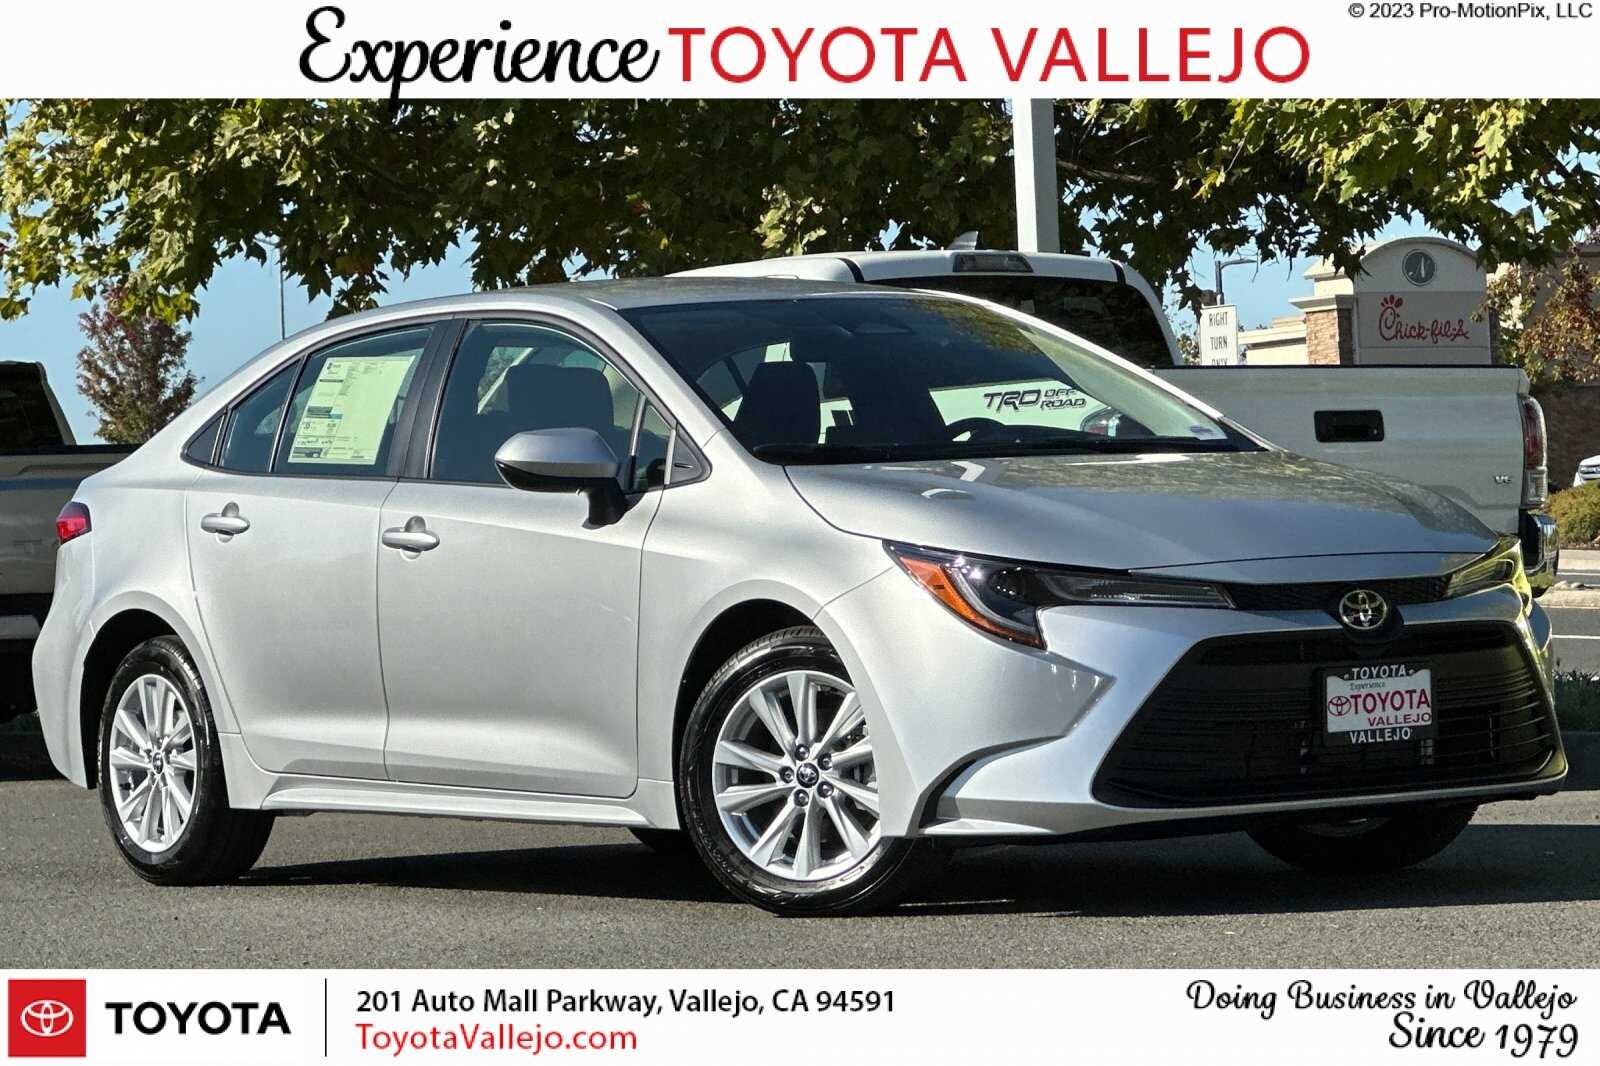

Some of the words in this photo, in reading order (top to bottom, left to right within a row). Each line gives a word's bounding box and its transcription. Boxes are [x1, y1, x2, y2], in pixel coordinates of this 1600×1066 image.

[1209, 311, 1228, 327] RIGHT
[1210, 335, 1228, 350] TURN
[1044, 388, 1076, 397] OFF
[984, 389, 1041, 413] TRD
[1040, 398, 1087, 410] ROAD
[1351, 664, 1407, 680] TOYOTA
[1350, 688, 1430, 715] TOYOTA
[1367, 712, 1432, 727] VALLEJO
[1349, 727, 1411, 745] VALLEJO
